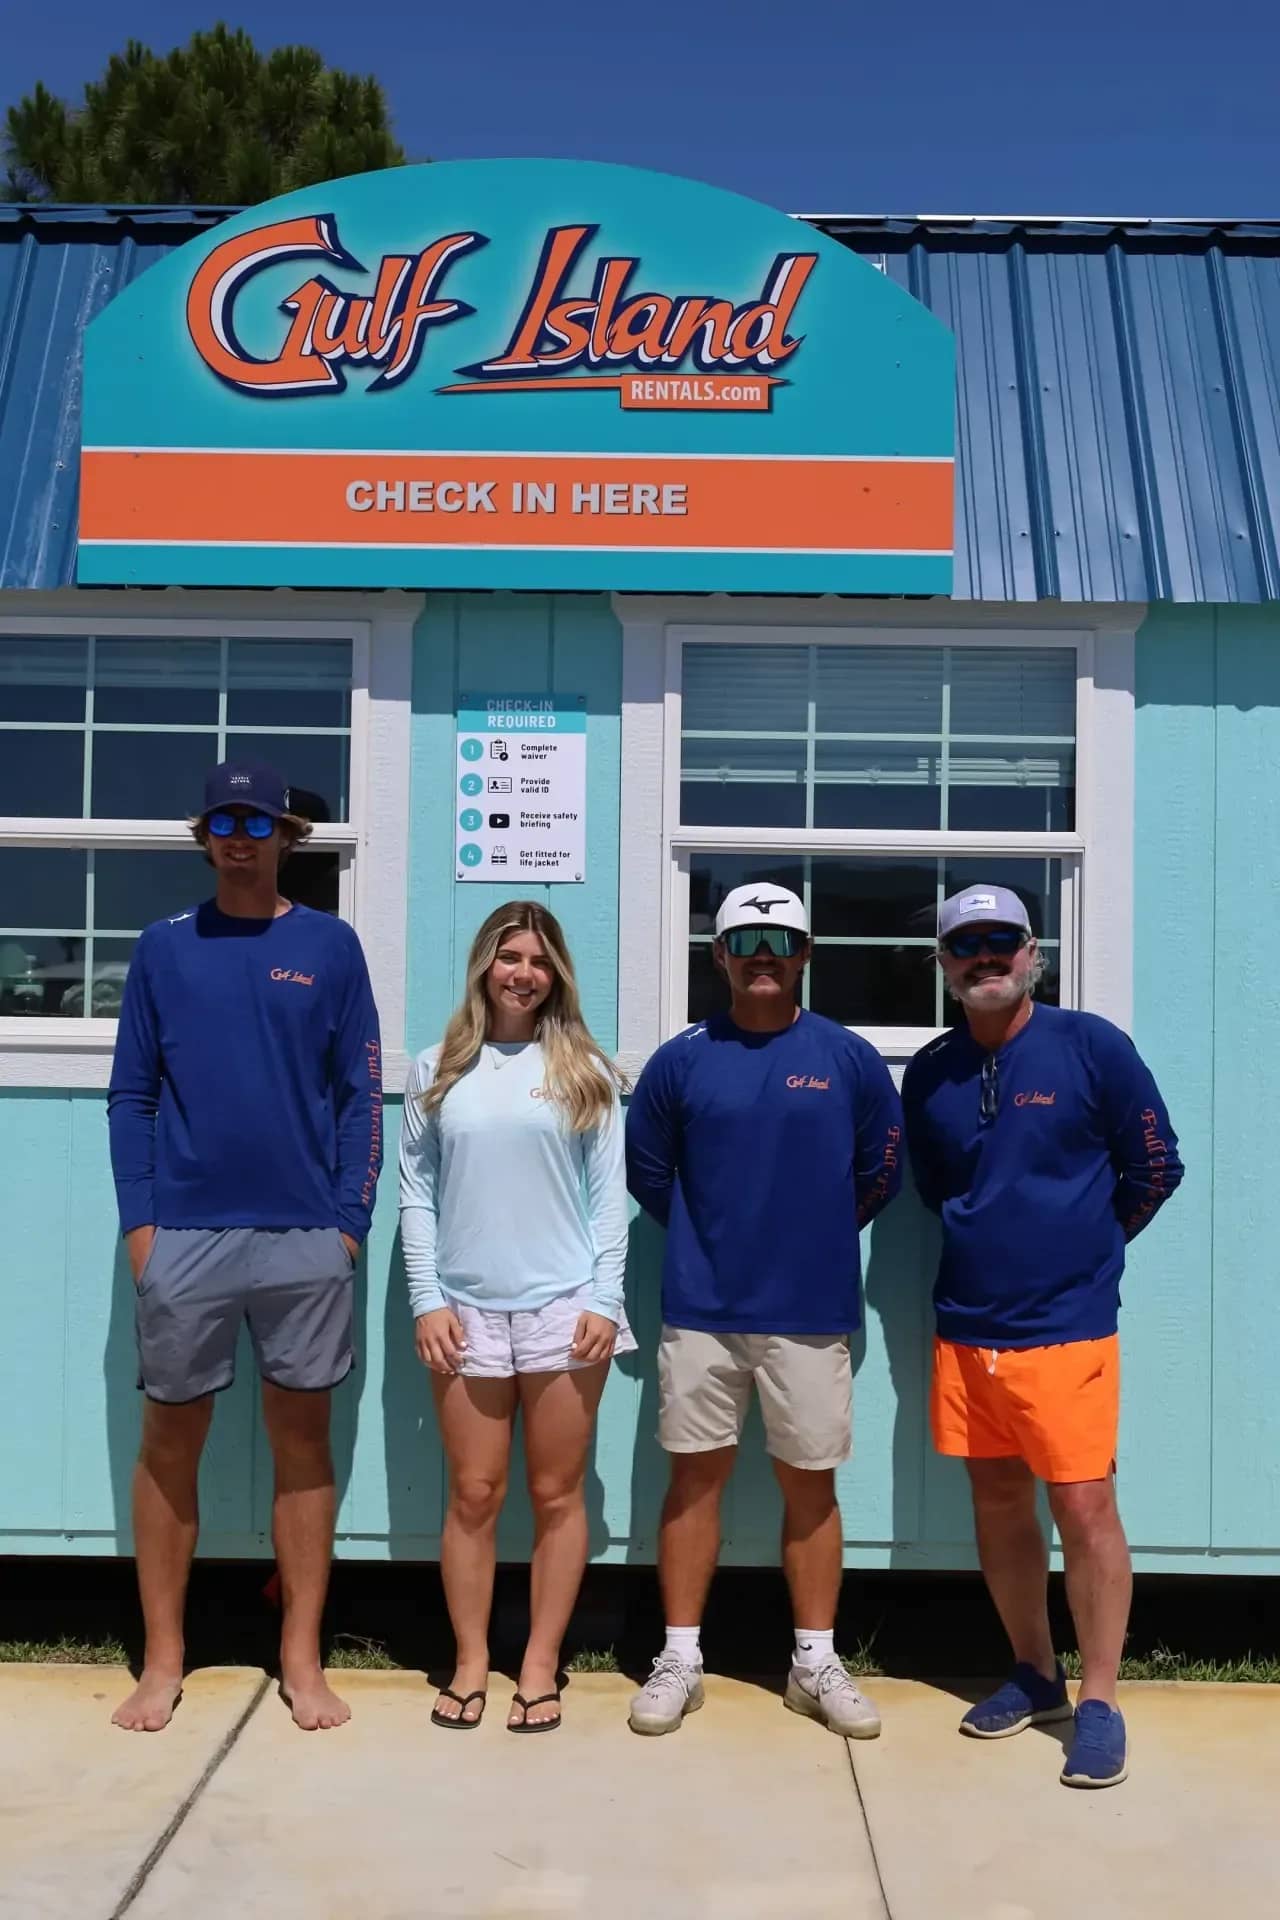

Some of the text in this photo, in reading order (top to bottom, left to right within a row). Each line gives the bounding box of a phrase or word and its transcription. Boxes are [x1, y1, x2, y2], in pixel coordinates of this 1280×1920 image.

[186, 213, 819, 397] Gulf Island
[631, 380, 761, 401] RENTALS.com
[345, 480, 689, 515] CHECK IN HERE
[487, 700, 554, 712] CHECK-IN
[487, 715, 556, 728] REQUIRED
[520, 744, 558, 752] Complete
[520, 786, 549, 794] valid ID
[520, 812, 578, 821] Receive safety
[520, 820, 551, 829] briefing
[519, 851, 571, 859] Get fitted for
[519, 859, 559, 868] life jacket
[365, 1039, 382, 1080] Full
[1140, 1108, 1168, 1154] Full
[884, 1125, 900, 1169] Full
